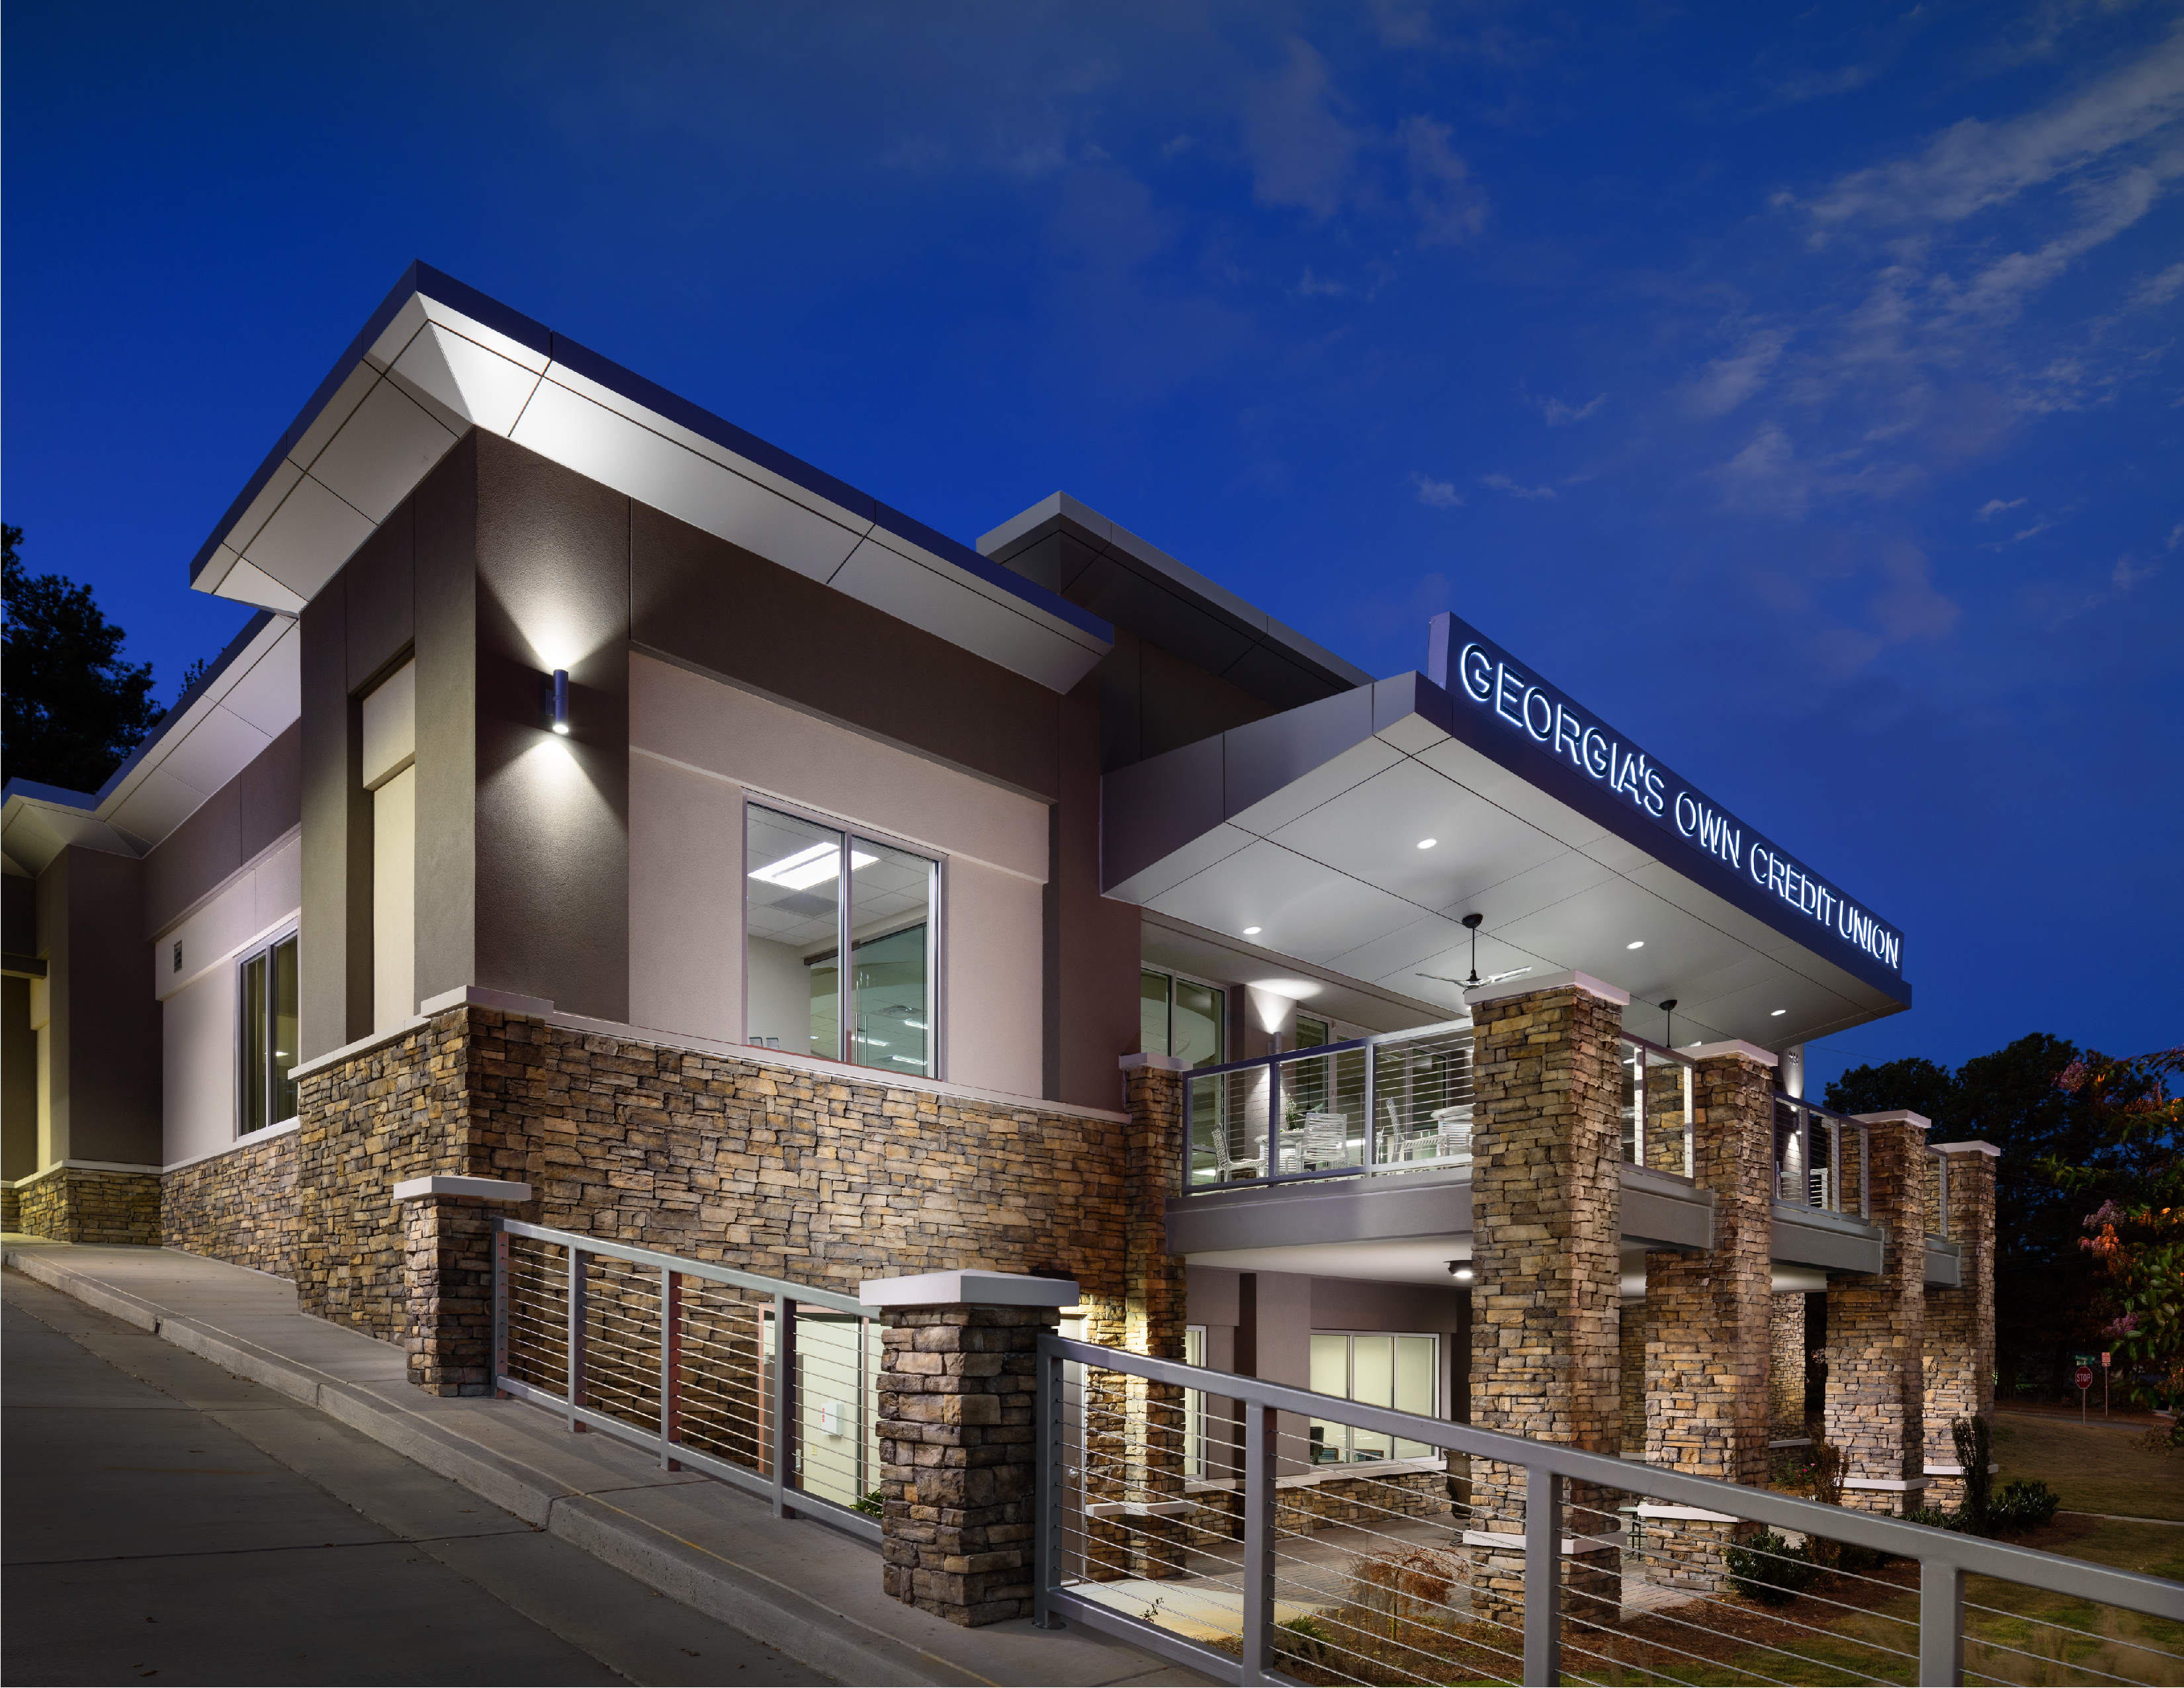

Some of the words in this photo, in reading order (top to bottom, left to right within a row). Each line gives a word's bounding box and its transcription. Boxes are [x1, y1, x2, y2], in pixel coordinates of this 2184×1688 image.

[1462, 644, 1665, 816] GEORGIA'S
[1676, 792, 1741, 868] OWN
[1751, 843, 1837, 926] CREDIT
[1839, 901, 1899, 969] UNION
